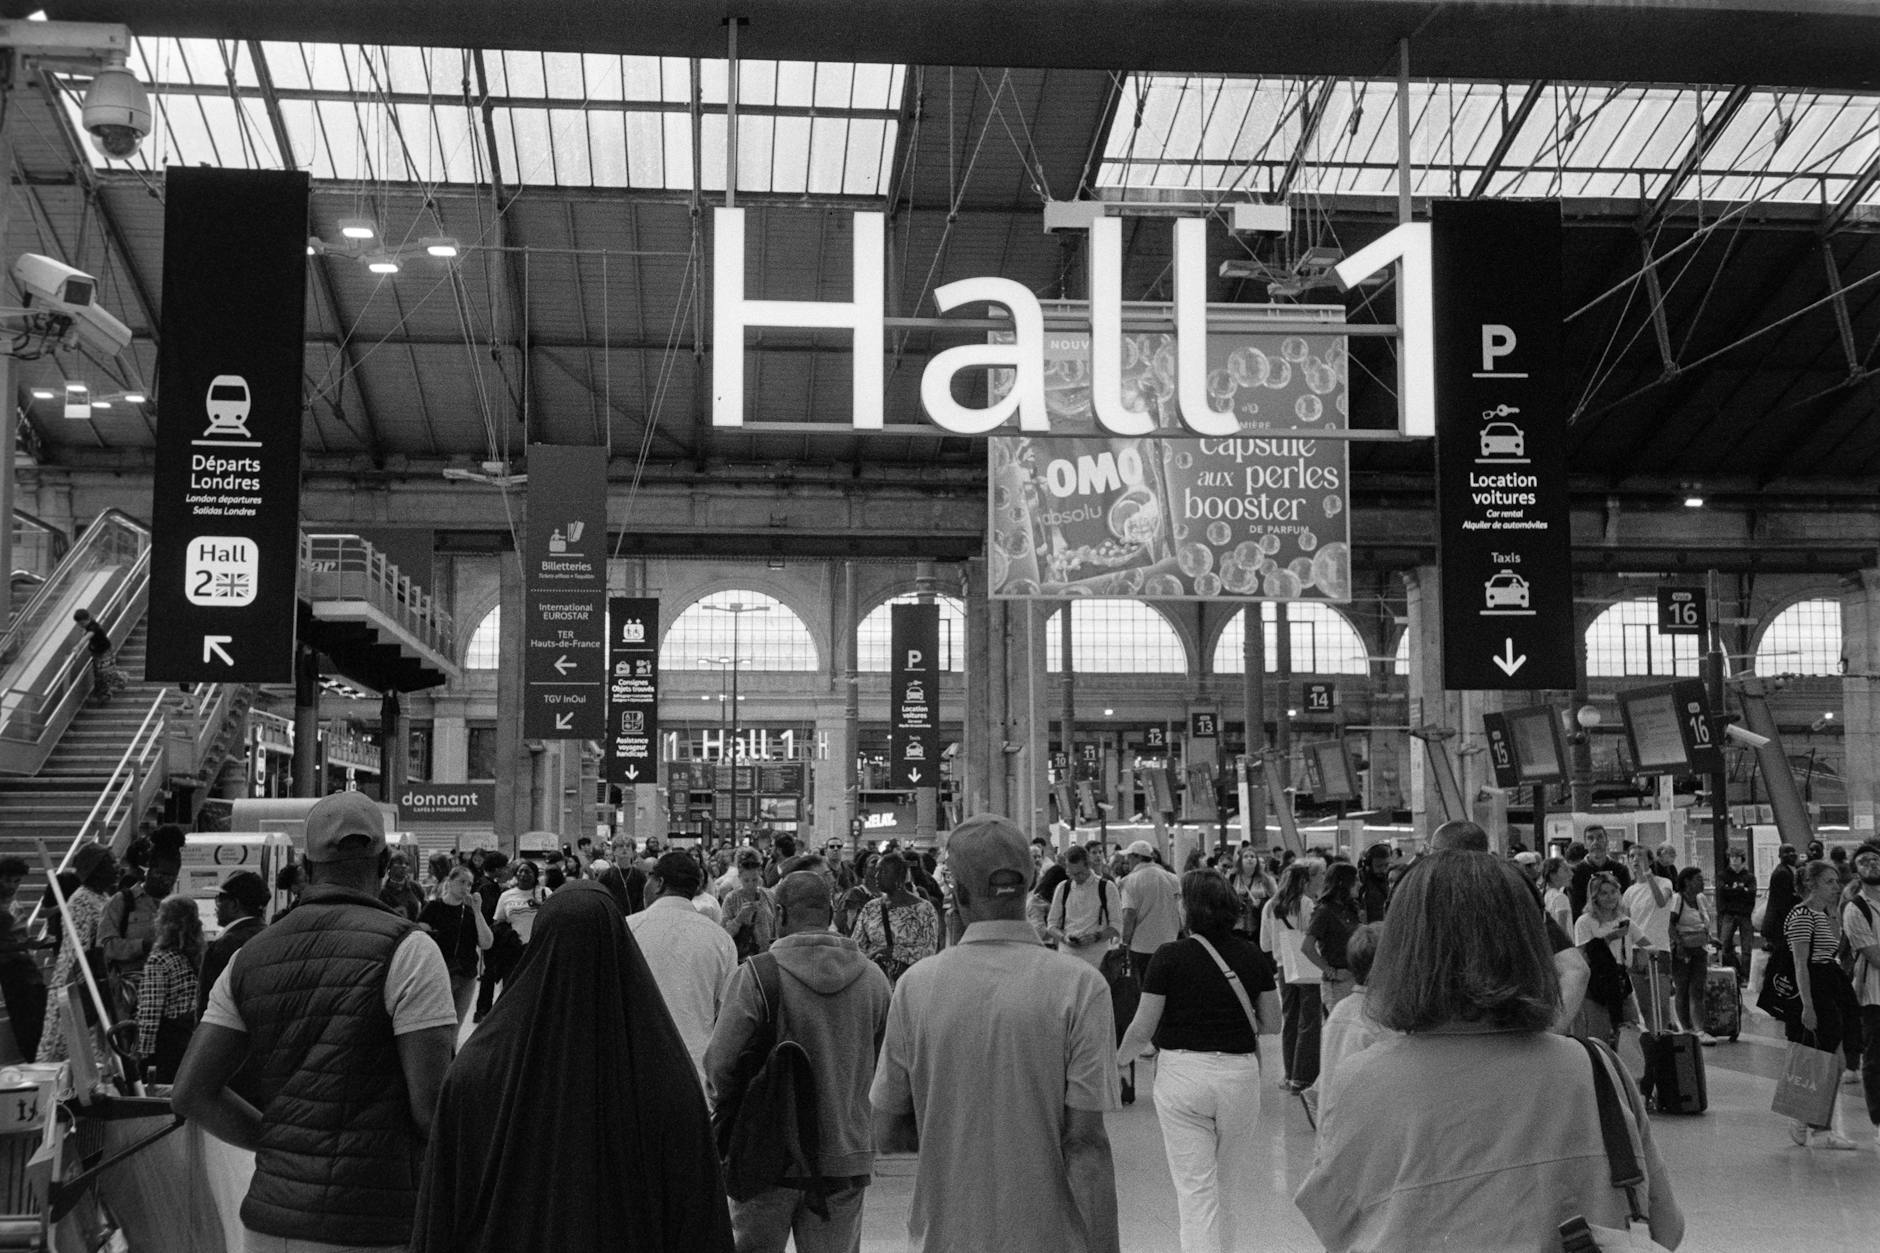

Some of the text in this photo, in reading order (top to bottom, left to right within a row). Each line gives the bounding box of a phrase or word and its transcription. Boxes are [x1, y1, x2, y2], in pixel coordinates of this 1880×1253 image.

[712, 206, 1436, 437] Hall 1
[1050, 340, 1090, 350] NOUV
[1482, 324, 1517, 370] P
[1239, 420, 1271, 430] MIÈRE
[191, 454, 261, 475] Départs
[1046, 447, 1143, 498] OMO
[1196, 457, 1339, 495] aux perles
[1469, 471, 1538, 487] Location
[190, 473, 261, 490] Londres
[185, 494, 262, 505] London departures
[1184, 487, 1307, 521] booster
[1471, 489, 1536, 505] voitures
[192, 505, 256, 516] Salidas Londres
[1041, 503, 1102, 526] absolu
[1486, 509, 1523, 518] Car rental
[1249, 525, 1310, 535] DE PARFUM
[1462, 520, 1548, 531] Alquiler de automóviles
[199, 544, 247, 563] Hall
[1491, 552, 1521, 563] Taxis
[541, 560, 592, 571] Billetteries
[193, 569, 213, 597] 2
[539, 603, 593, 612] International
[1668, 602, 1698, 624] 16
[543, 611, 589, 620] EUROSTAR
[557, 630, 574, 639] TER
[530, 639, 601, 649] Hauts-de-France
[908, 649, 922, 668] P
[543, 694, 561, 704] TGV
[1309, 692, 1329, 707] 14
[1197, 720, 1214, 733] 13
[1689, 714, 1710, 743] 16
[702, 729, 794, 760] Hall 1
[1148, 731, 1162, 744] 12
[1083, 749, 1096, 759] 11
[1493, 741, 1509, 764] 15
[401, 791, 479, 806] donnant
